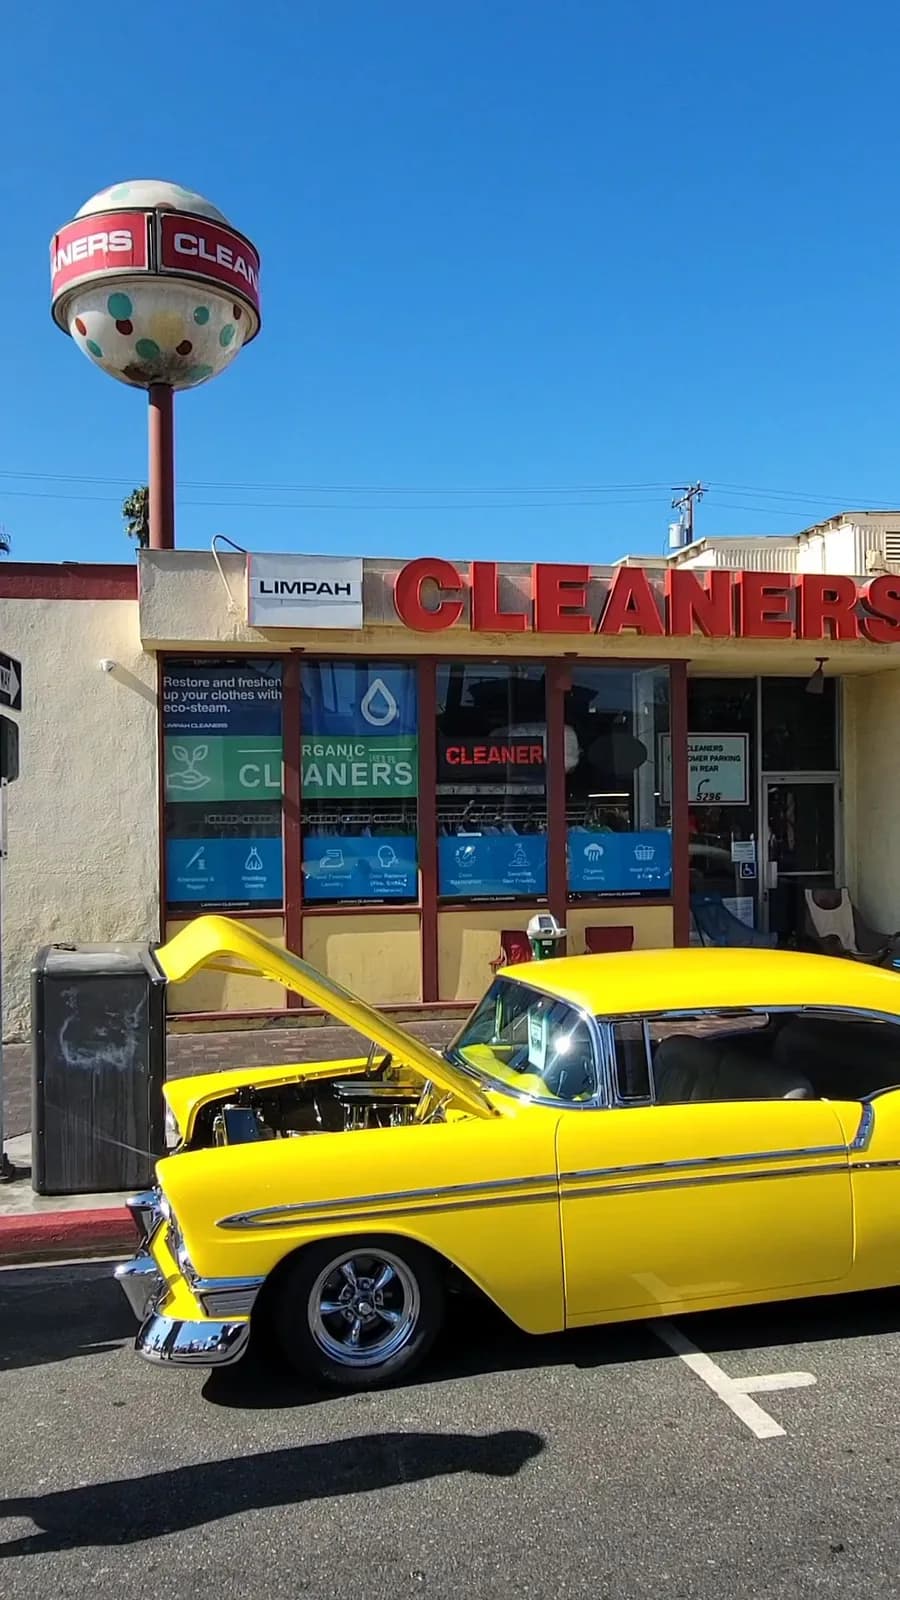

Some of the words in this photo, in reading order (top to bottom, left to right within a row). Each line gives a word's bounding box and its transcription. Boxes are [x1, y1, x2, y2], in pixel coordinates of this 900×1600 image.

[53, 230, 133, 272] NERS
[260, 581, 351, 595] LIMPAH
[394, 556, 900, 643] CLEANERS
[163, 677, 210, 687] Restore
[213, 678, 235, 687] and
[238, 678, 282, 687] freshen
[163, 690, 179, 701] up
[182, 690, 208, 701] your
[211, 689, 254, 700] clothes
[257, 689, 282, 699] with
[163, 702, 231, 713] eco-steam.
[239, 762, 412, 788] CLANERS
